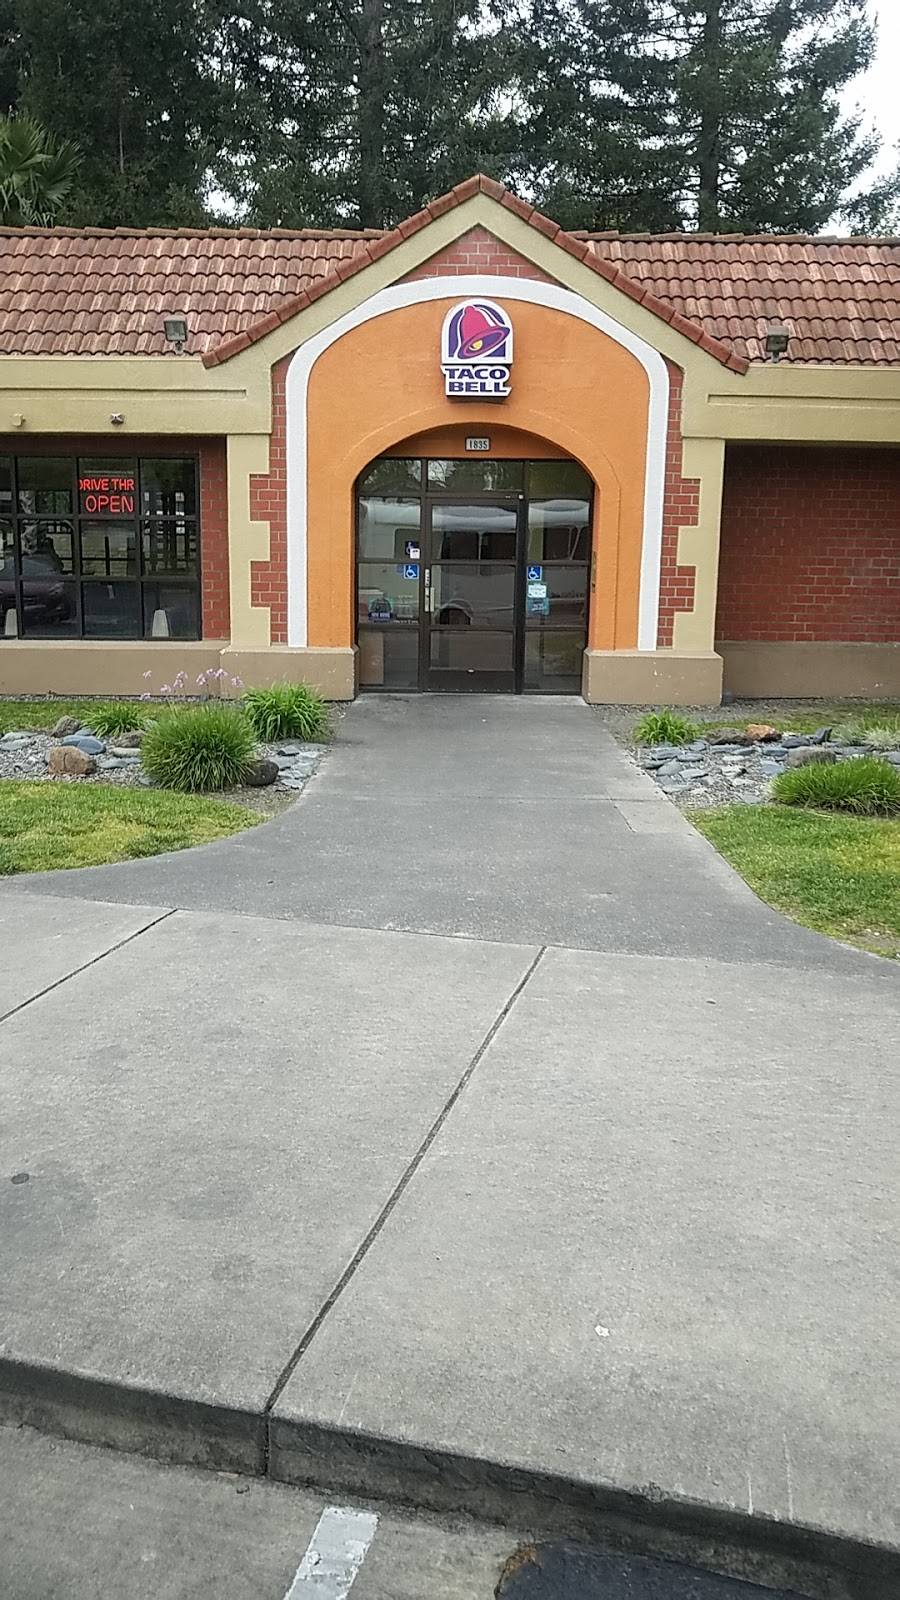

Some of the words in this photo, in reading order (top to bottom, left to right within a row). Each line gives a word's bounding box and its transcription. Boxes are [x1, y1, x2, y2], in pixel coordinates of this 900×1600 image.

[445, 368, 507, 380] TACO
[448, 381, 507, 393] BELL
[469, 440, 488, 449] 1835
[85, 495, 134, 513] OPEN
